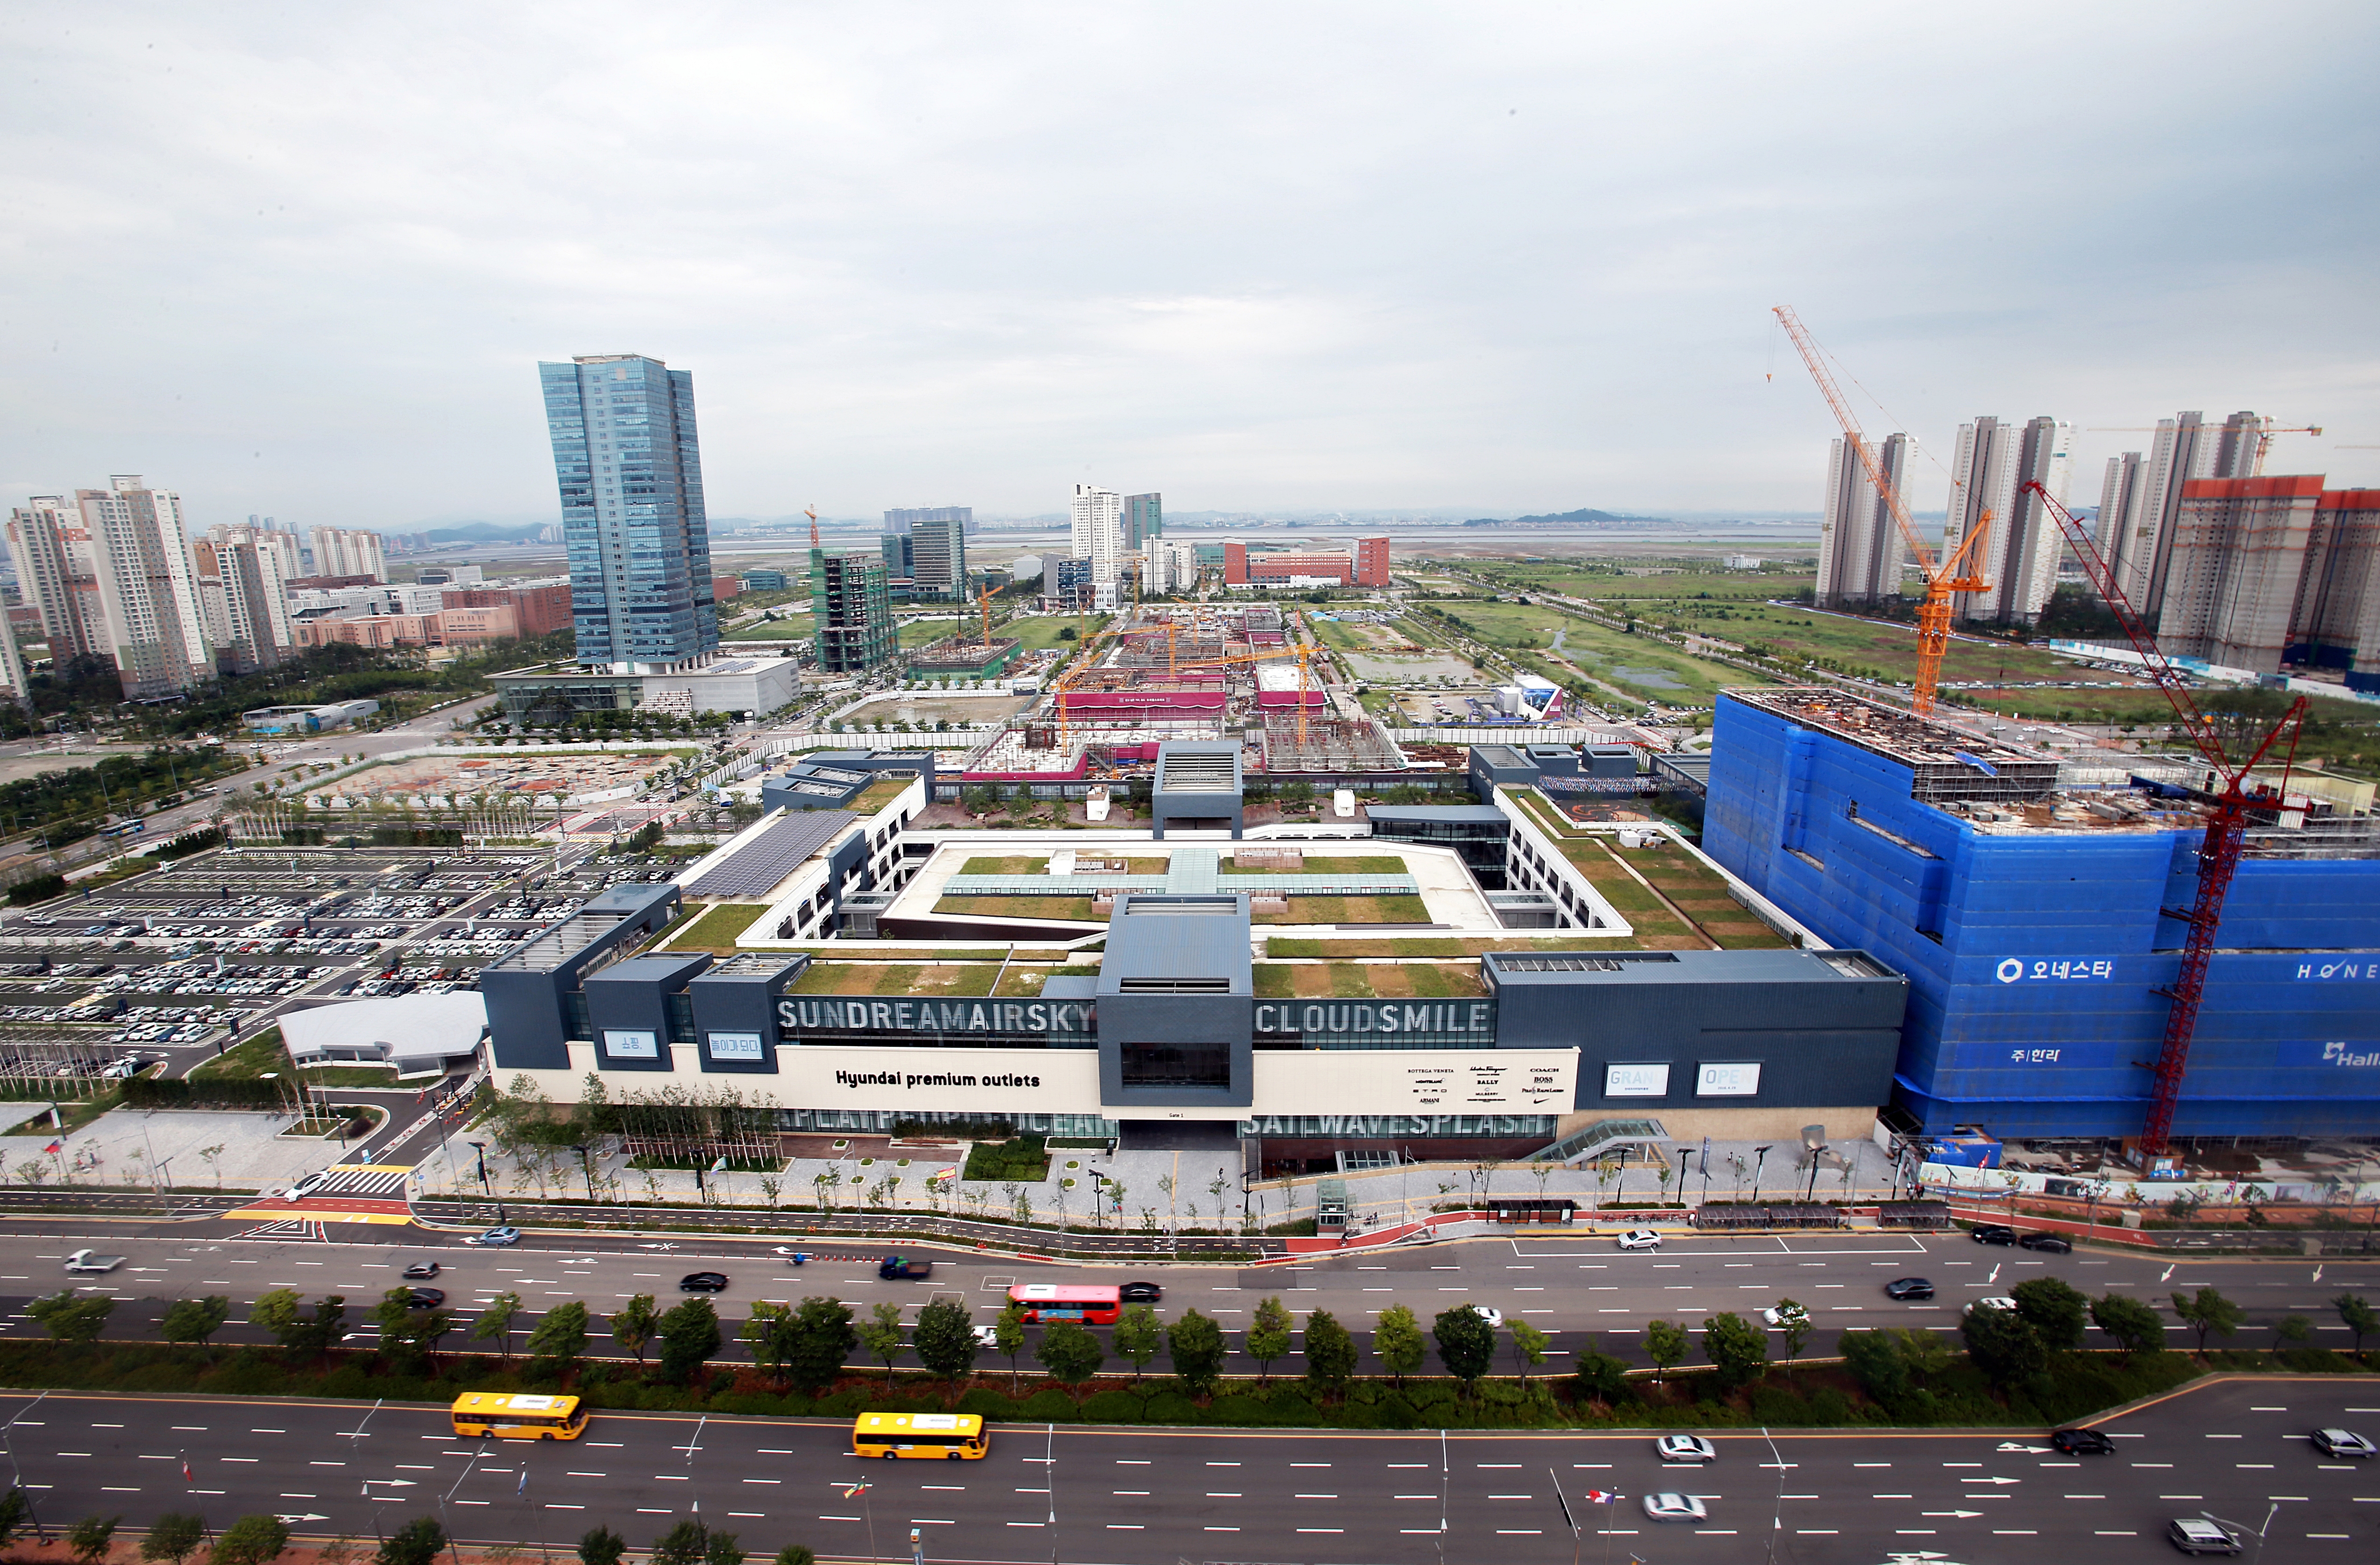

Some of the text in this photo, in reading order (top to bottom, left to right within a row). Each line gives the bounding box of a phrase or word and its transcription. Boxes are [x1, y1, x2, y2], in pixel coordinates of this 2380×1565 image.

[2029, 960, 2112, 980] 오네스타
[2337, 1052, 2380, 1066] Hall
[836, 1070, 1040, 1089] Hyundai premium outlets
[1706, 1069, 1753, 1084] OPEN
